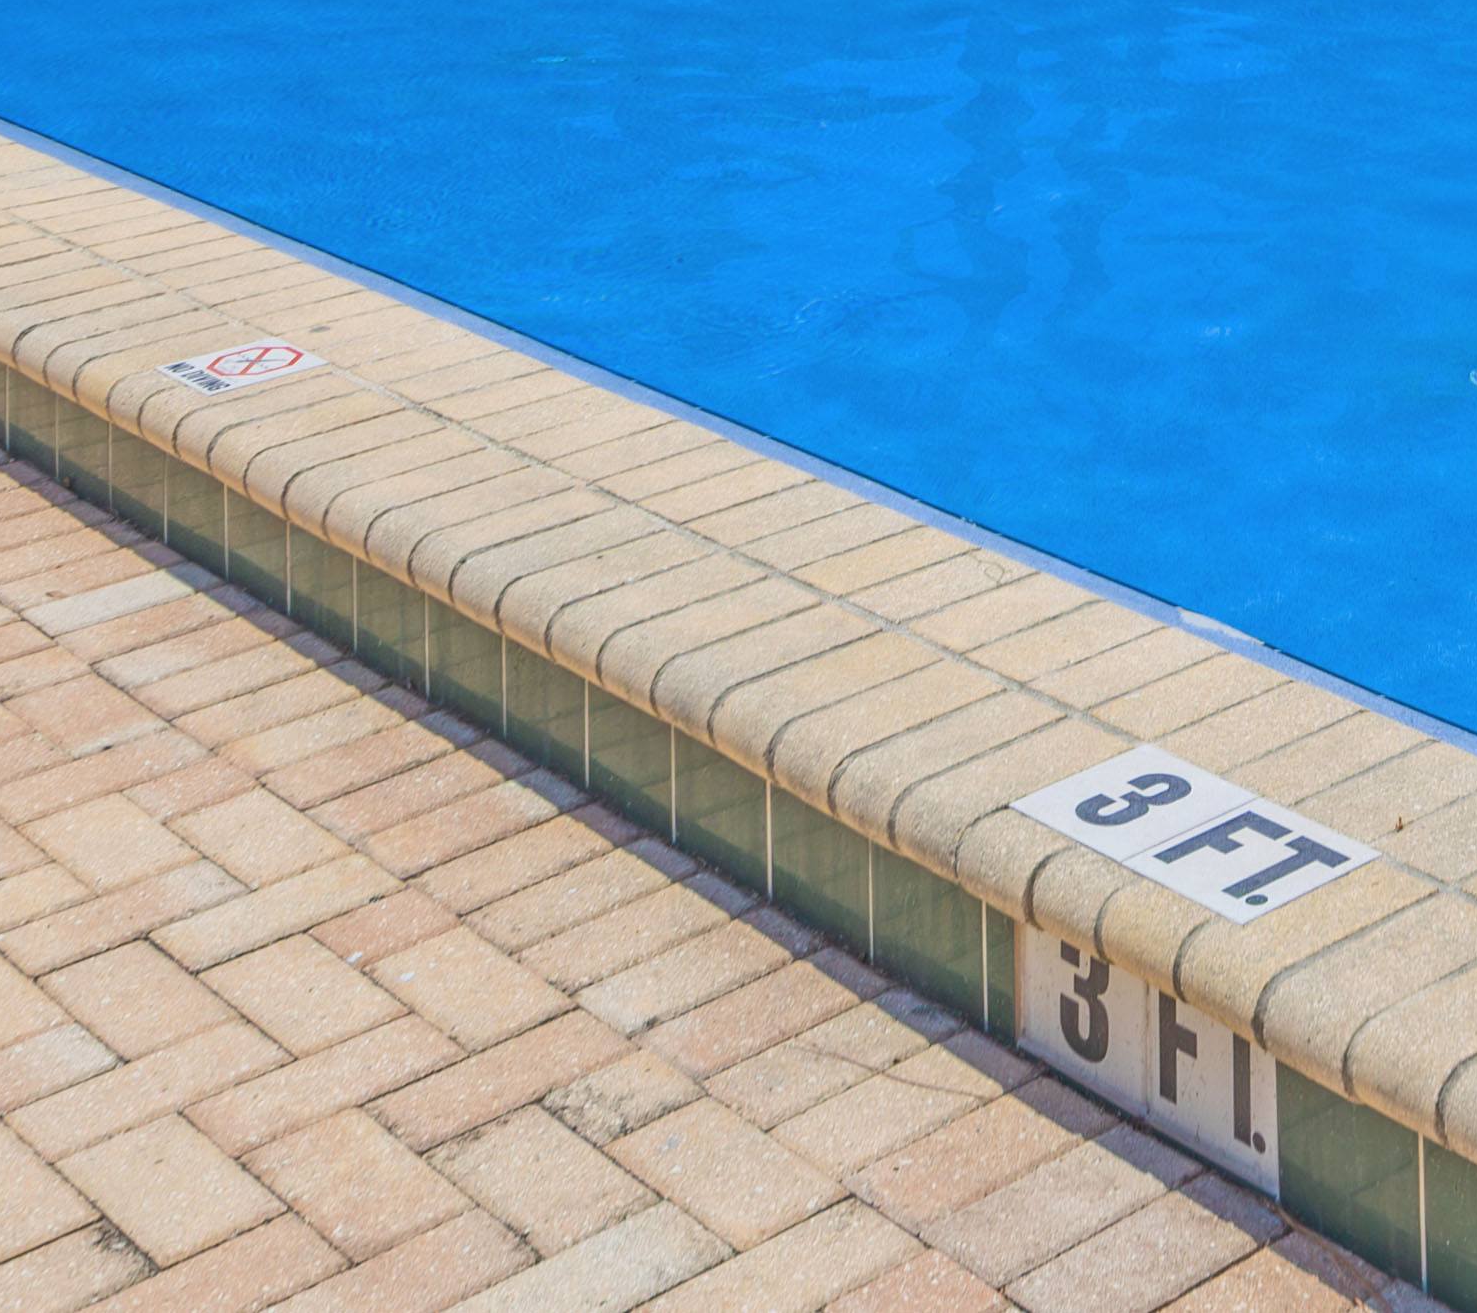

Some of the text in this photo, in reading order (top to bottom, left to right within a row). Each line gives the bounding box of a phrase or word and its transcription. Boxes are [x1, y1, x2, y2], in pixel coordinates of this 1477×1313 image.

[163, 362, 231, 391] NO DIVING
[1075, 773, 1351, 906] 3 FT.
[1060, 941, 1111, 1064] 3
